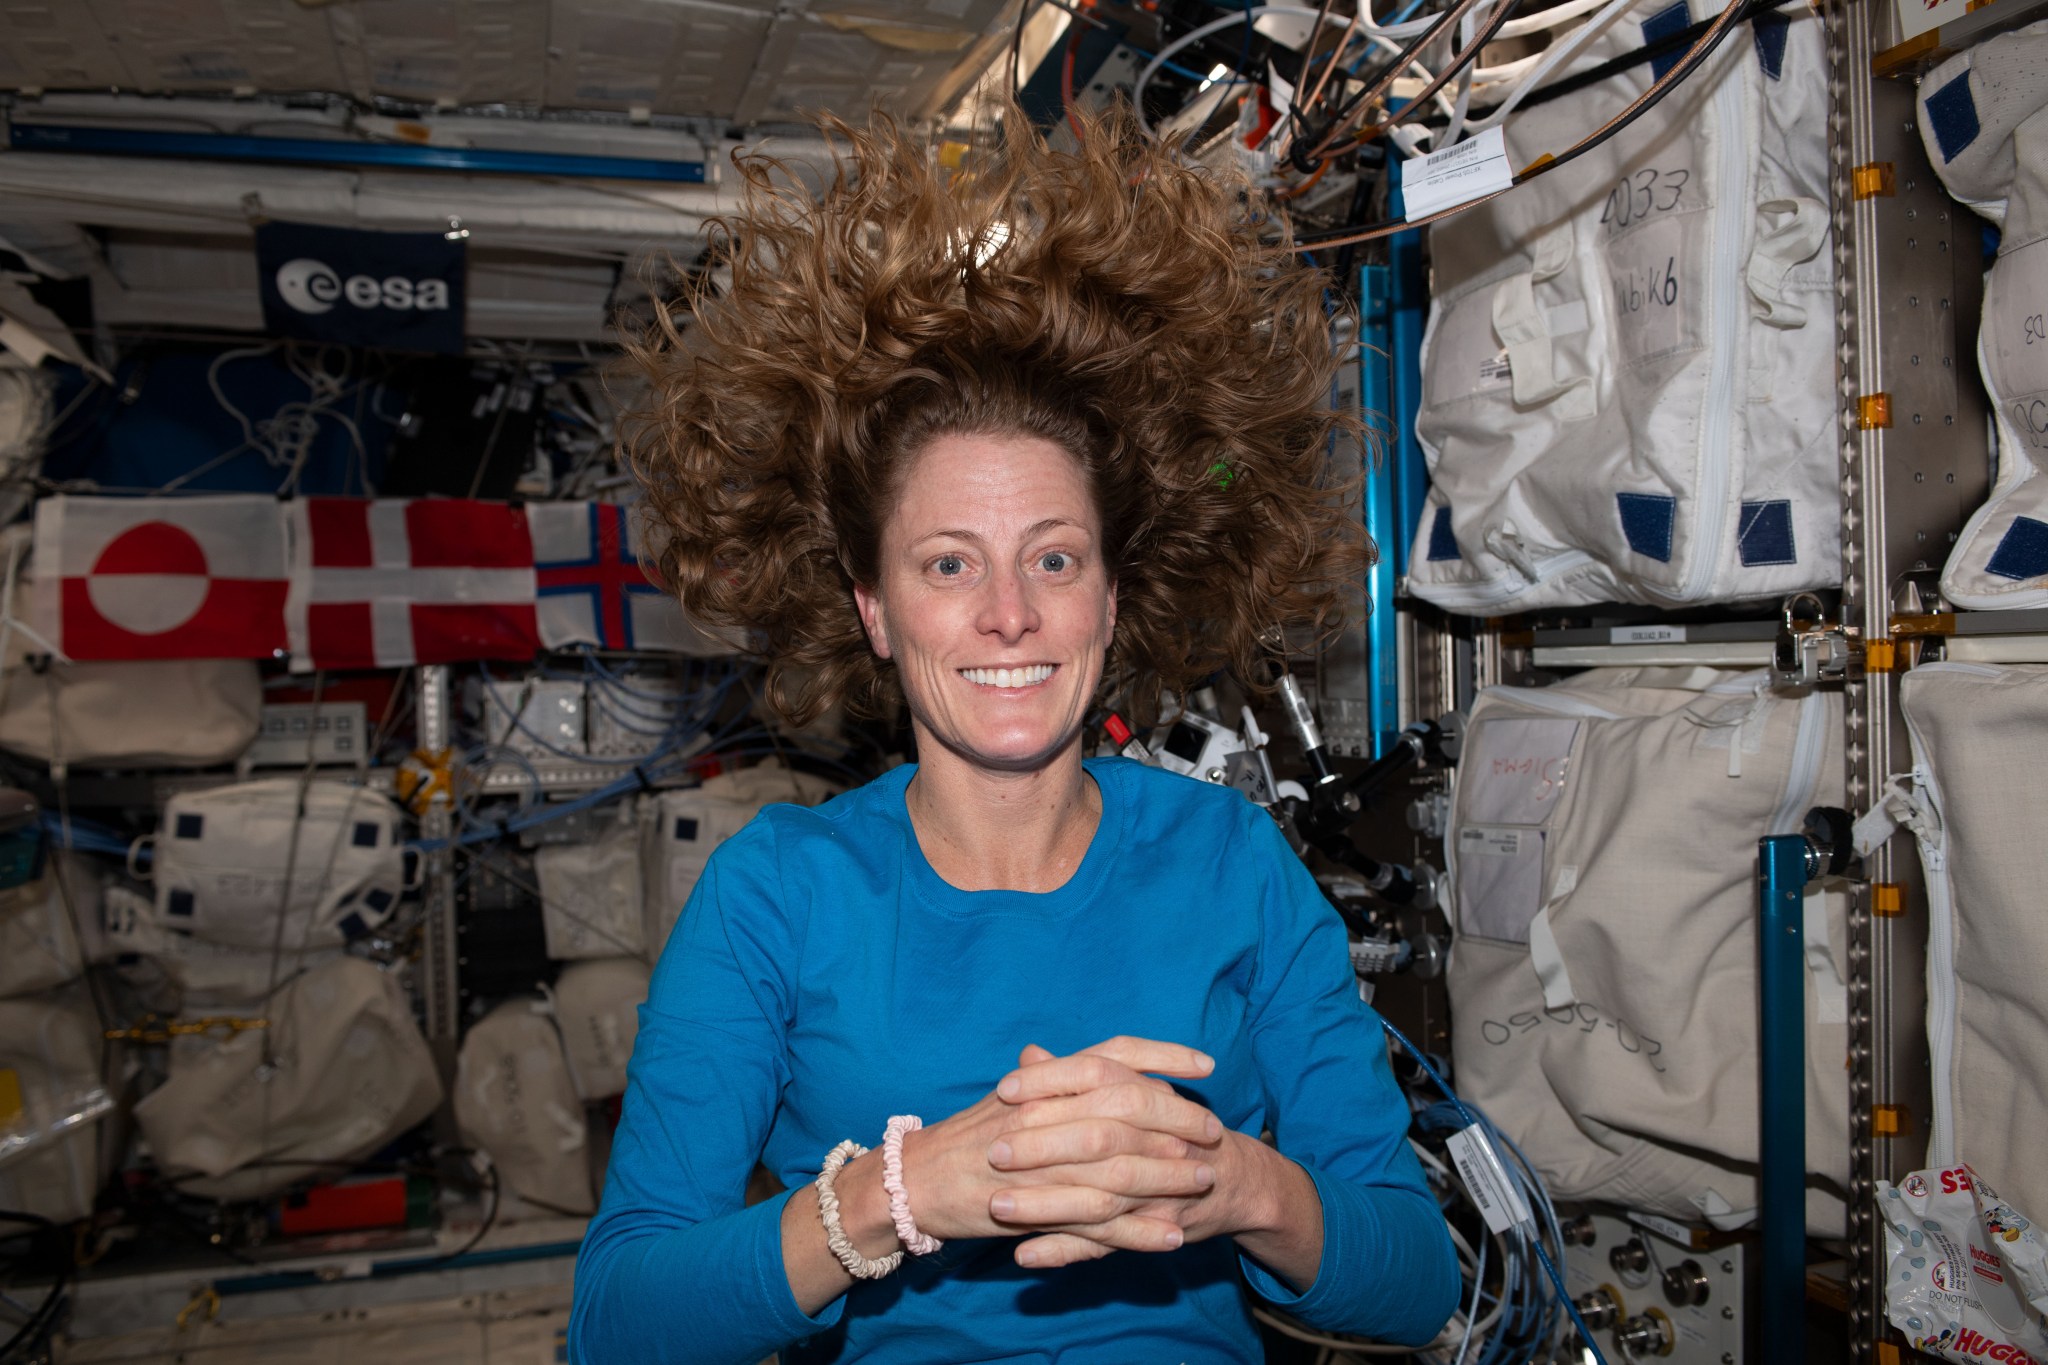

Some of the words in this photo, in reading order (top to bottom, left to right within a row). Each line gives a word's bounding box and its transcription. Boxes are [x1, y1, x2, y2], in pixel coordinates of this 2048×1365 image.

[344, 274, 450, 312] esa
[1969, 1243, 2001, 1268] HUGGIES
[1929, 1290, 1943, 1300] DO
[1944, 1293, 1963, 1304] NOT
[1953, 1327, 2045, 1365] HUGG
